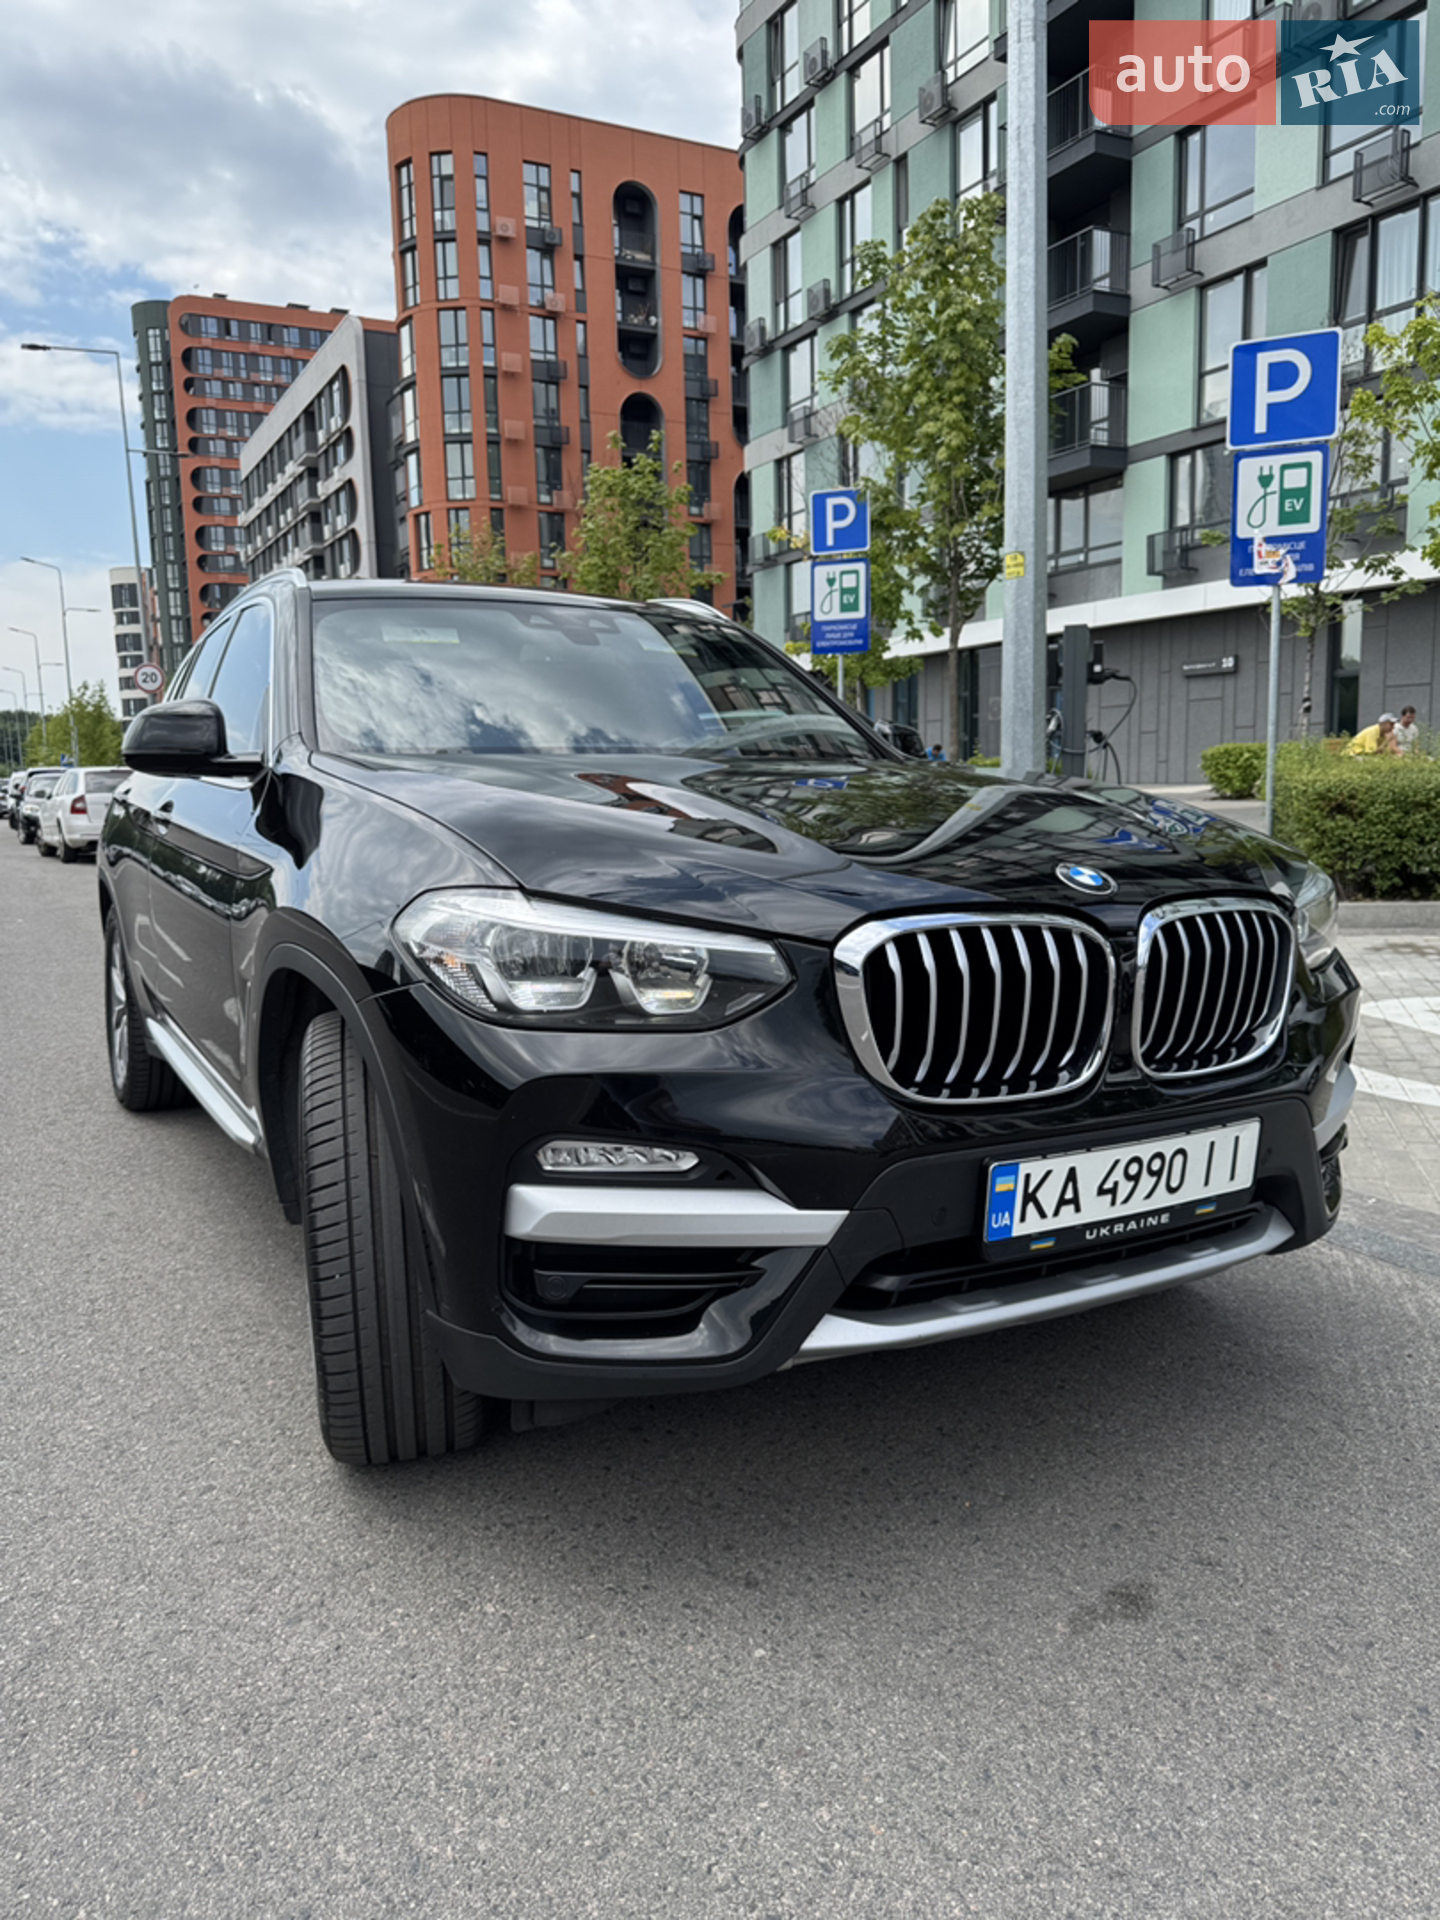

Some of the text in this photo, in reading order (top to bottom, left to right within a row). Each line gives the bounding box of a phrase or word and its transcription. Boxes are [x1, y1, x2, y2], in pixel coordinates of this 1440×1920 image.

[1254, 348, 1312, 435] P
[1284, 497, 1304, 512] EV
[826, 496, 857, 547] P
[843, 593, 856, 605] EV
[141, 672, 158, 683] 20
[1096, 1147, 1189, 1208] 4990
[991, 1210, 1011, 1229] UA
[1085, 1213, 1172, 1241] UKRAINE
